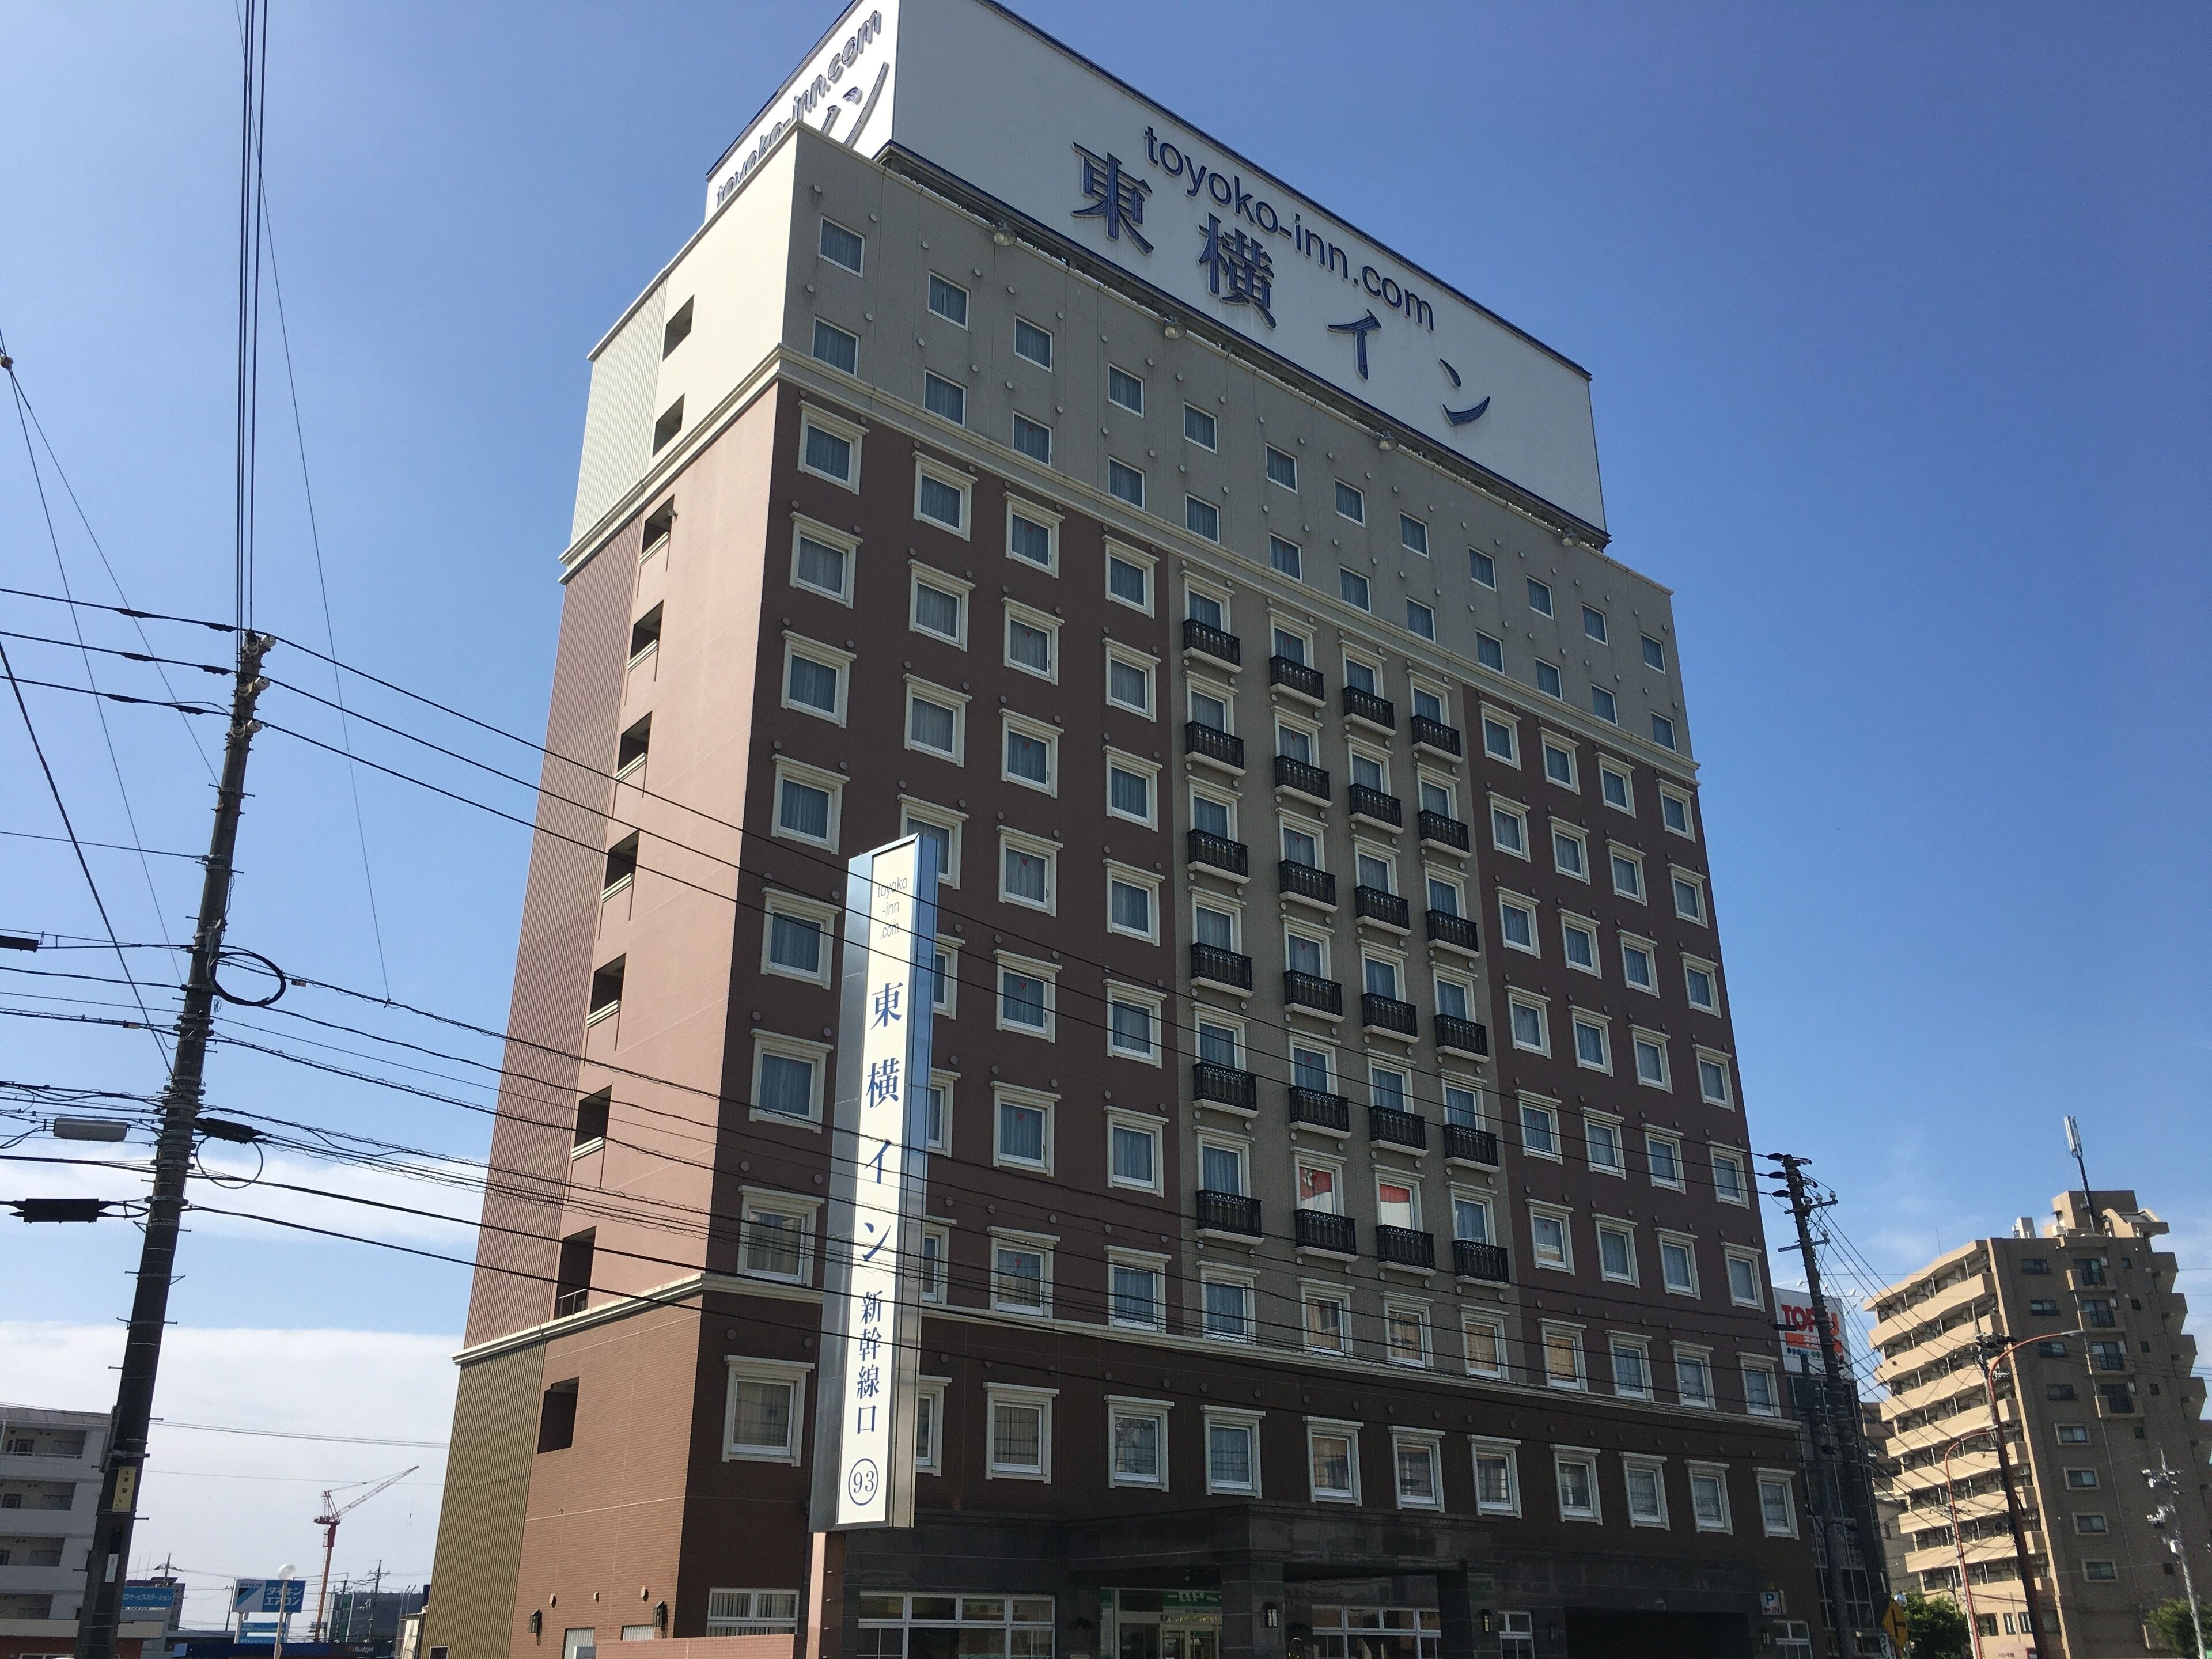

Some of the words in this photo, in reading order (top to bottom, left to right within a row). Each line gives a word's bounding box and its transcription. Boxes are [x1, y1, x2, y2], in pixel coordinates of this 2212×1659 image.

[1144, 126, 1434, 331] toyoko-inn.com
[1071, 141, 1491, 425] 東横イン
[877, 876, 908, 899] toyoko
[882, 900, 900, 916] -inn
[880, 922, 899, 940] .com
[862, 981, 904, 1262] 東横イン
[855, 1290, 883, 1435] 新幹線口
[853, 1469, 875, 1494] 93
[1766, 1593, 1774, 1606] P
[1771, 1605, 1779, 1613] IN
